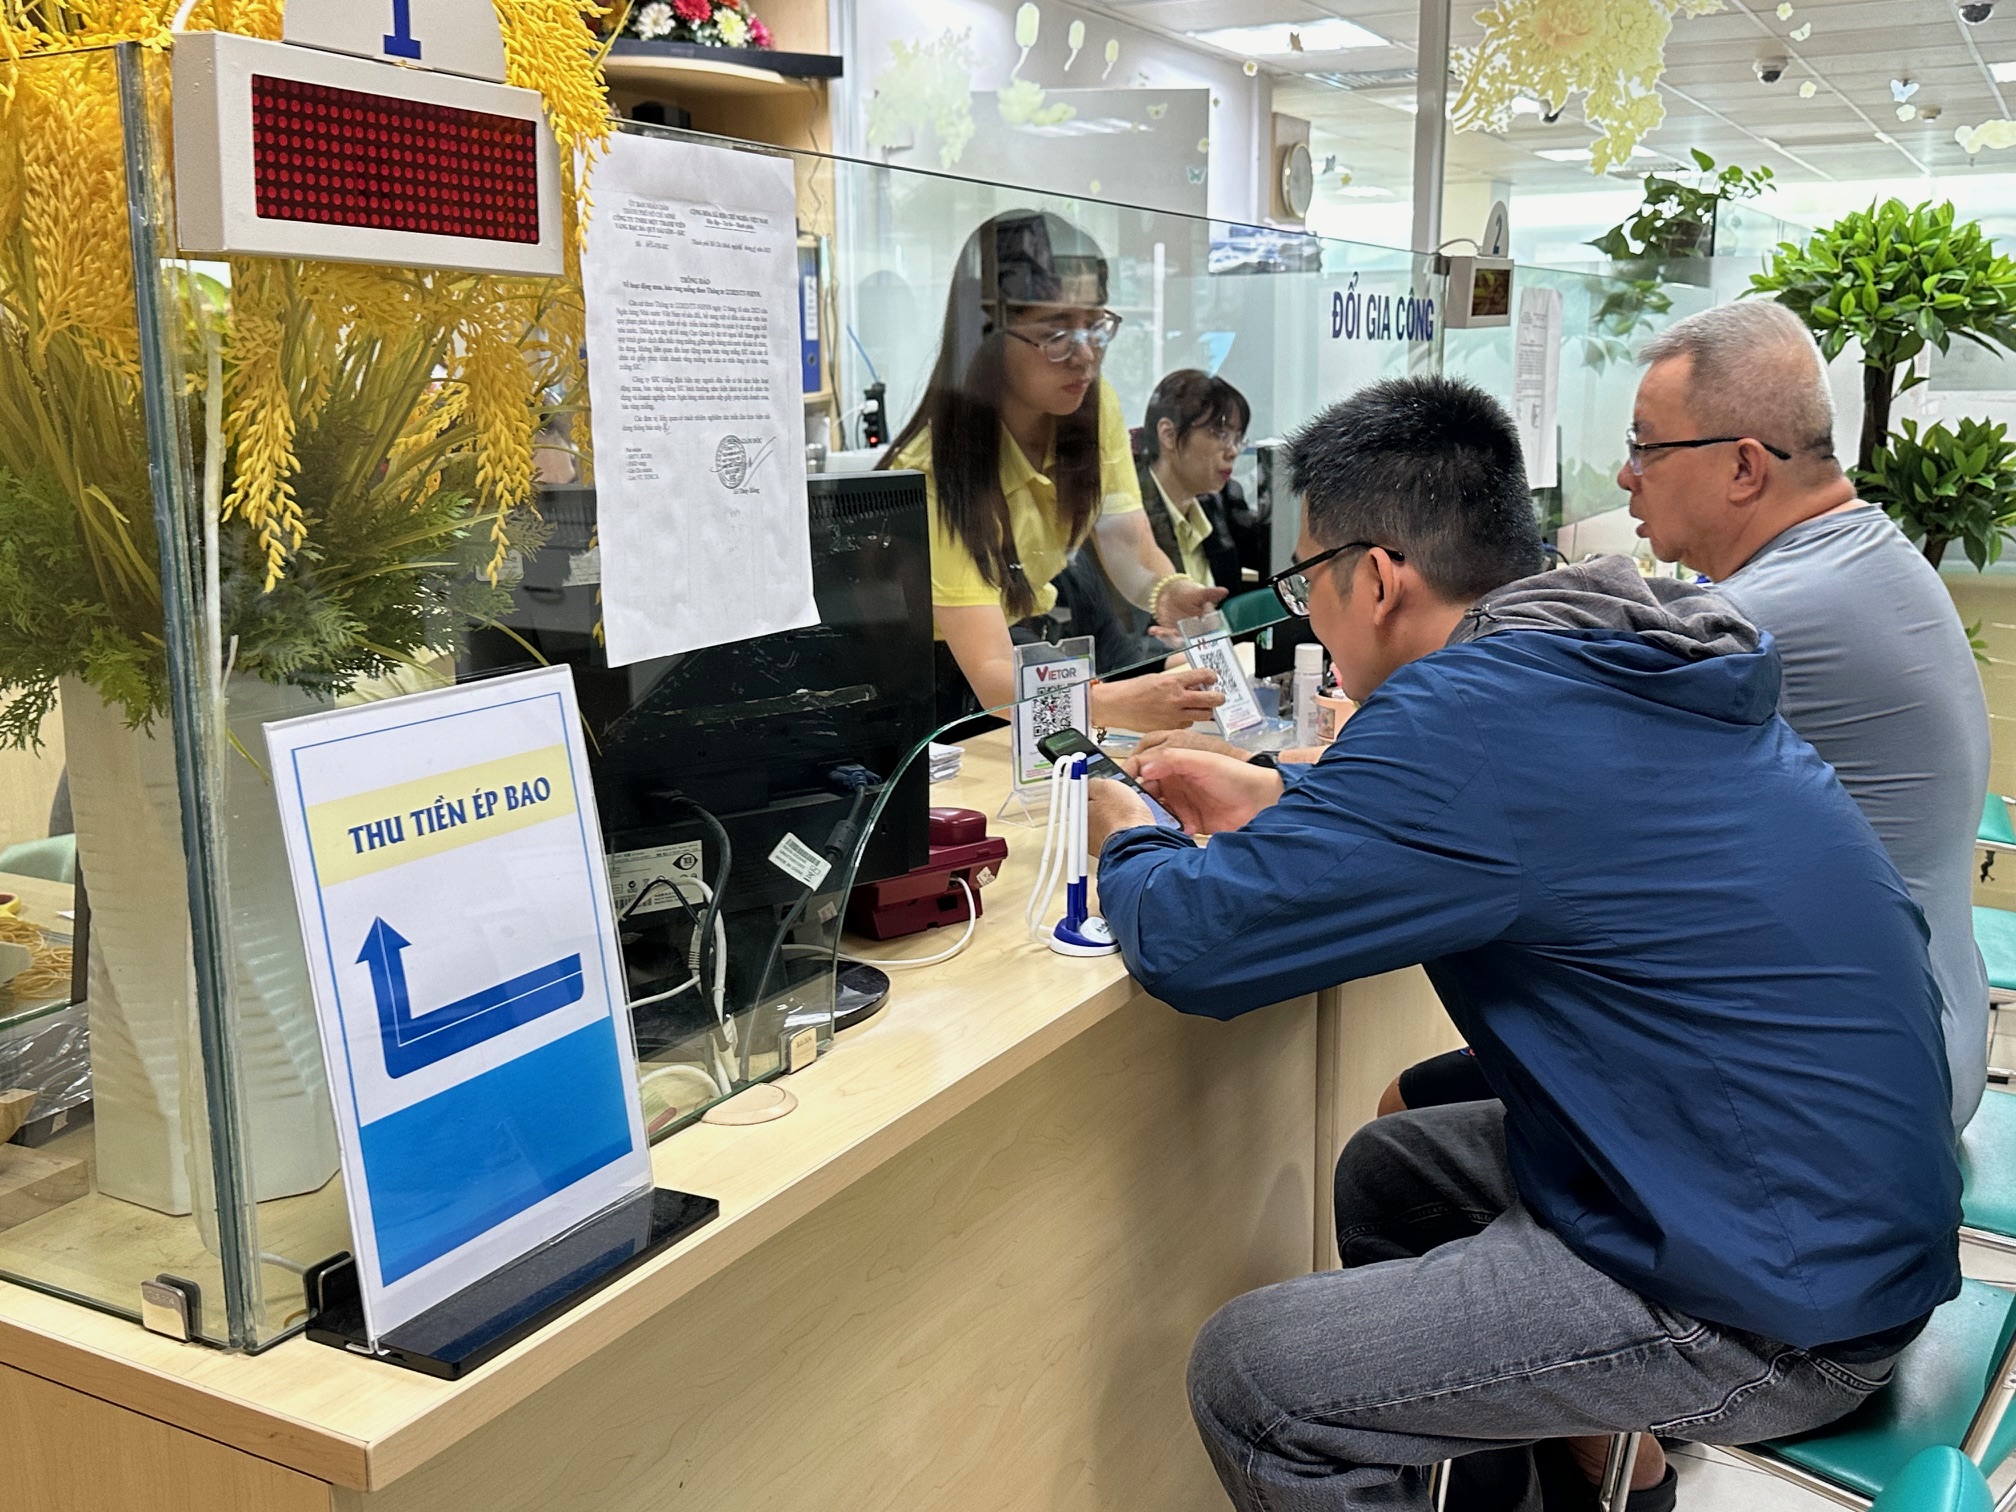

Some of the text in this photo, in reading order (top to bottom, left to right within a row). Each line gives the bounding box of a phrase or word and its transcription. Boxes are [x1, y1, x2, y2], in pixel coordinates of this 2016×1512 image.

[1492, 213, 1503, 255] 2
[1332, 271, 1434, 342] ĐỔI GIA CÔNG
[1036, 665, 1077, 682] VIETQR
[347, 776, 551, 854] THU TIỀN ÉP BAO
